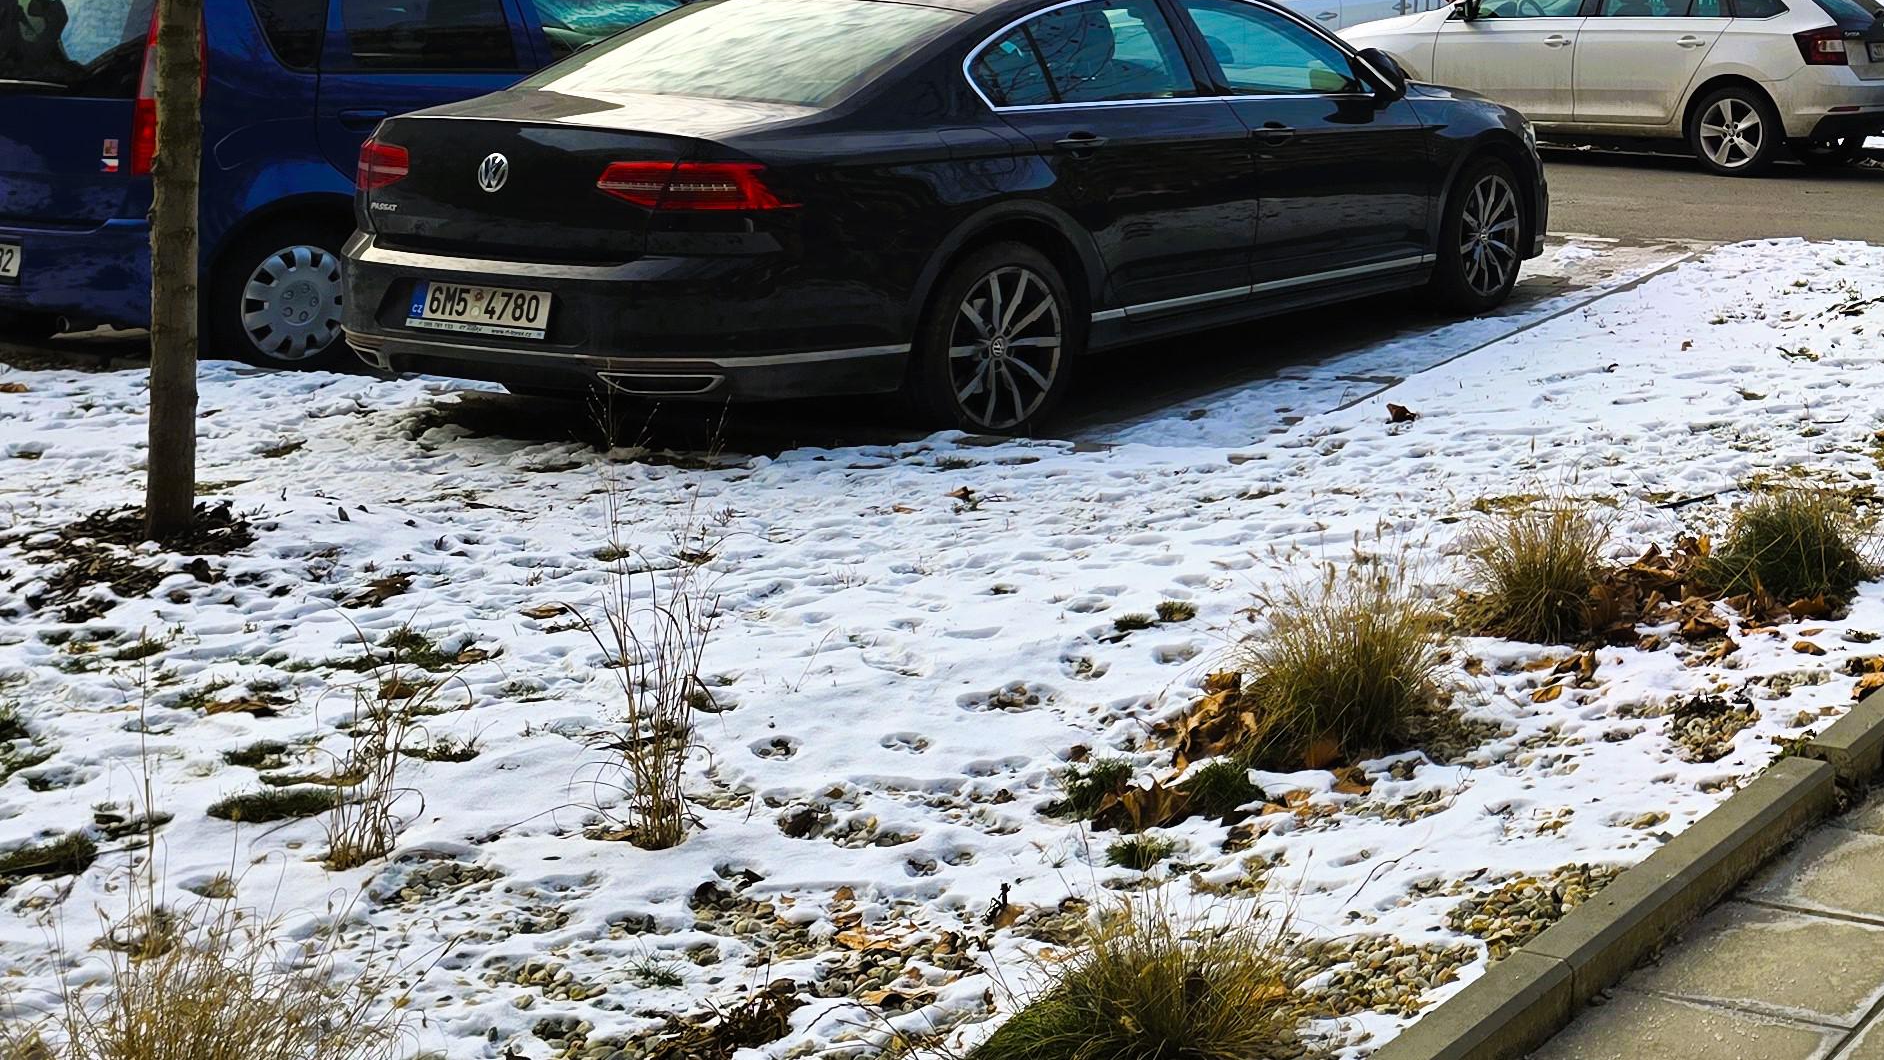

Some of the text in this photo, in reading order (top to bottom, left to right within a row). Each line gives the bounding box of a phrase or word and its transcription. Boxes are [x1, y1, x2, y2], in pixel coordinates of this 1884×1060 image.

[371, 202, 397, 212] PASSAT
[411, 286, 540, 324] CZ 6M5 4780
